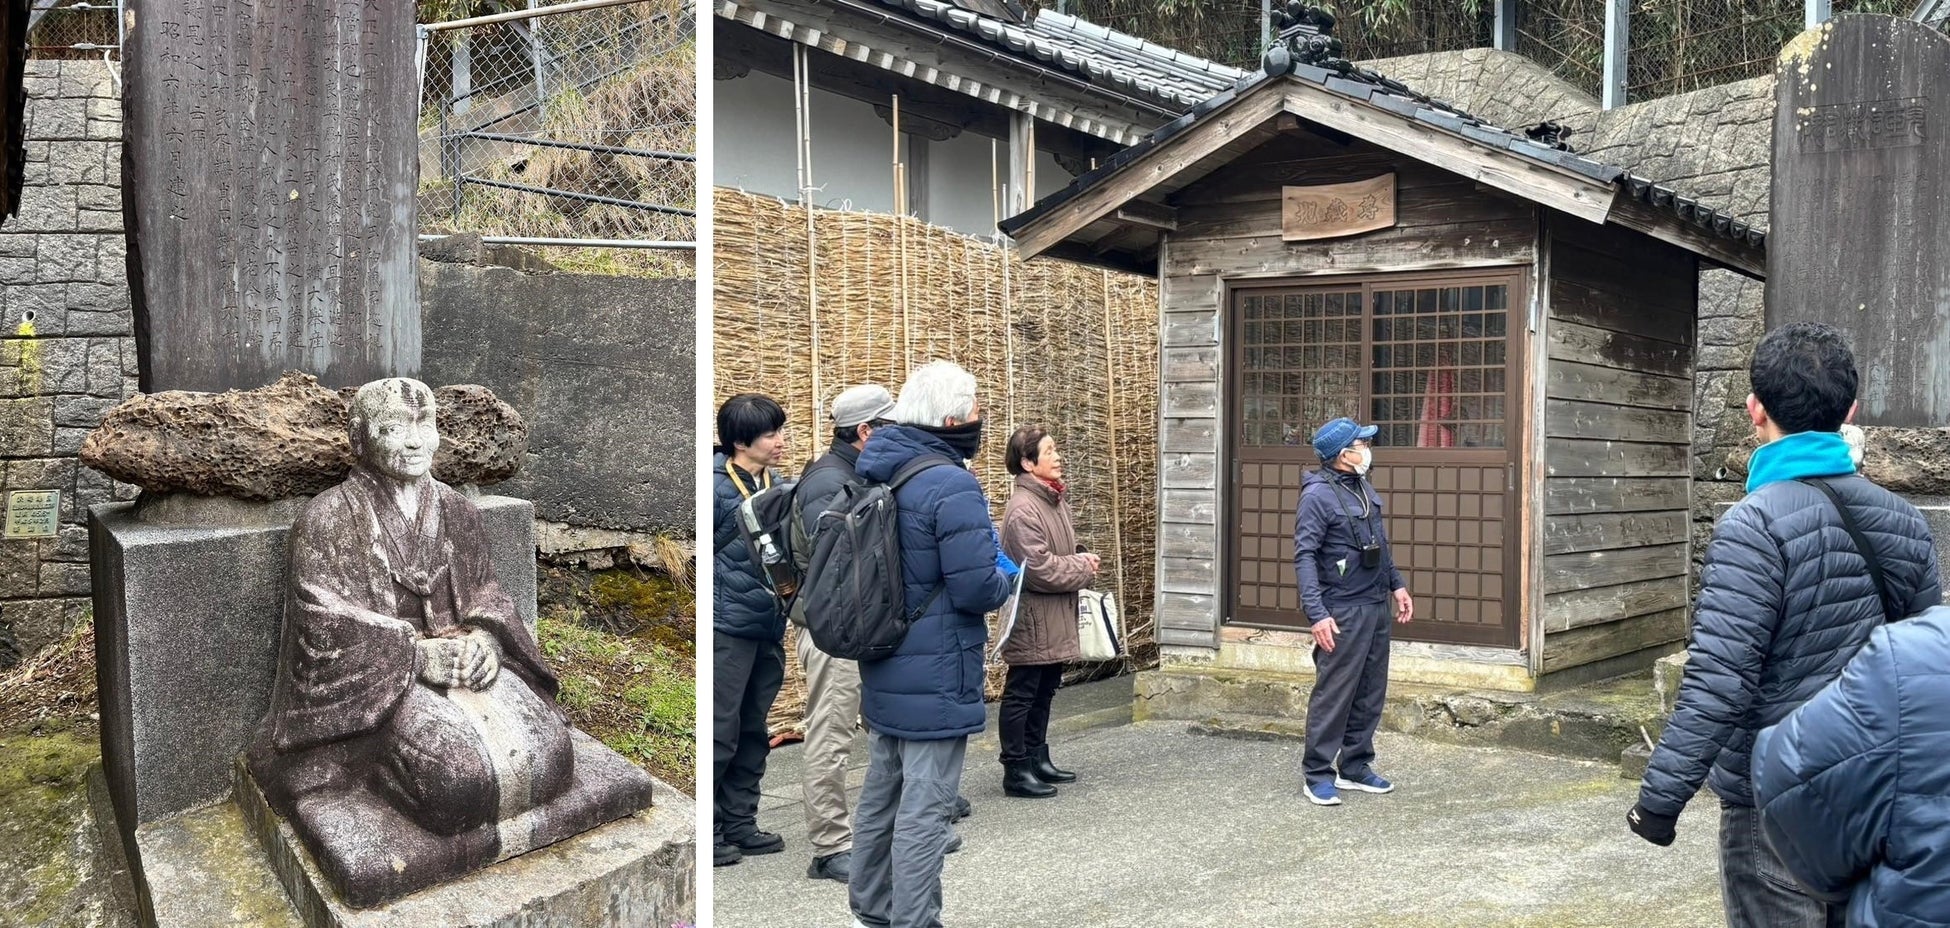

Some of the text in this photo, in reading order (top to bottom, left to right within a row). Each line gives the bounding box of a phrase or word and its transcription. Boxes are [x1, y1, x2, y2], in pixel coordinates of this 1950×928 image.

[160, 21, 190, 221] 昭和六年六月建之
